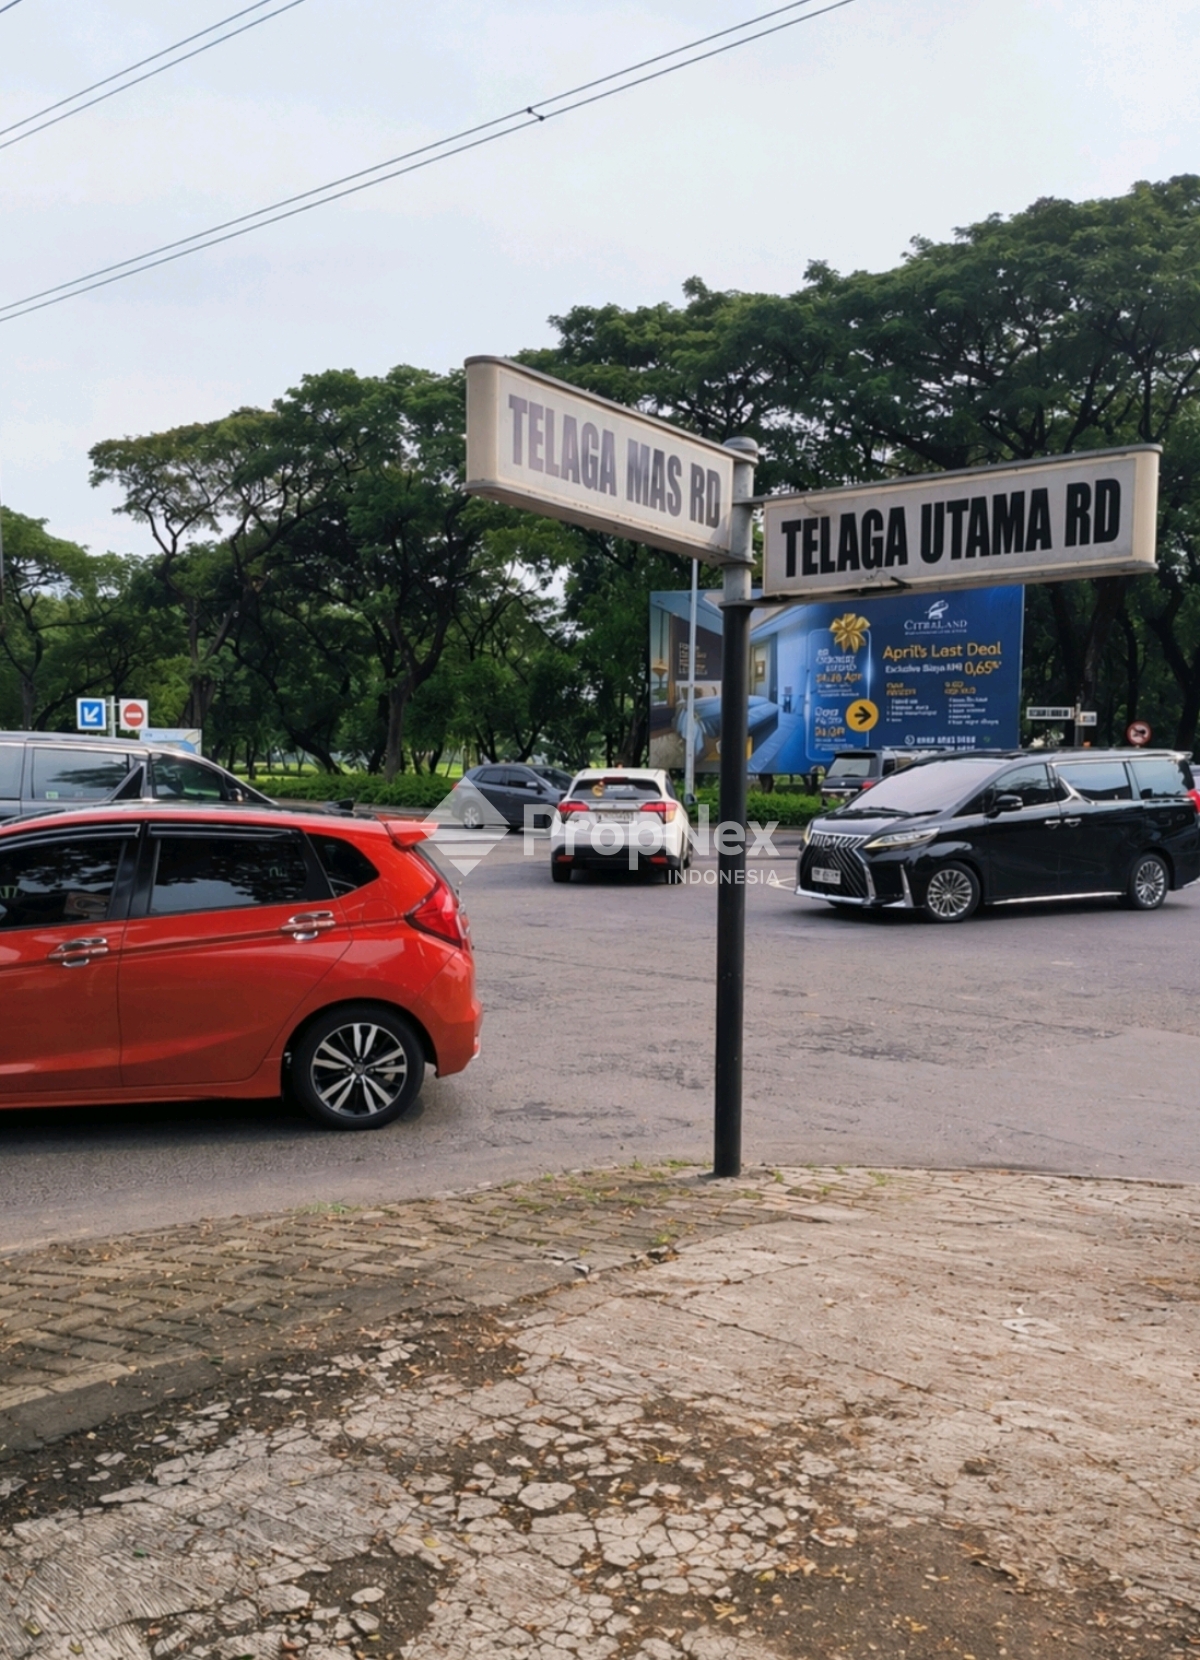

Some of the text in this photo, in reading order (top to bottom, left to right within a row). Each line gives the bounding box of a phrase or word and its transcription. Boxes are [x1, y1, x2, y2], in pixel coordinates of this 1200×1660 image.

[508, 395, 721, 530] TELAGA MAS RD
[781, 478, 1121, 578] TELAGA UTAMA RD
[882, 641, 1002, 661] April's Last Deal
